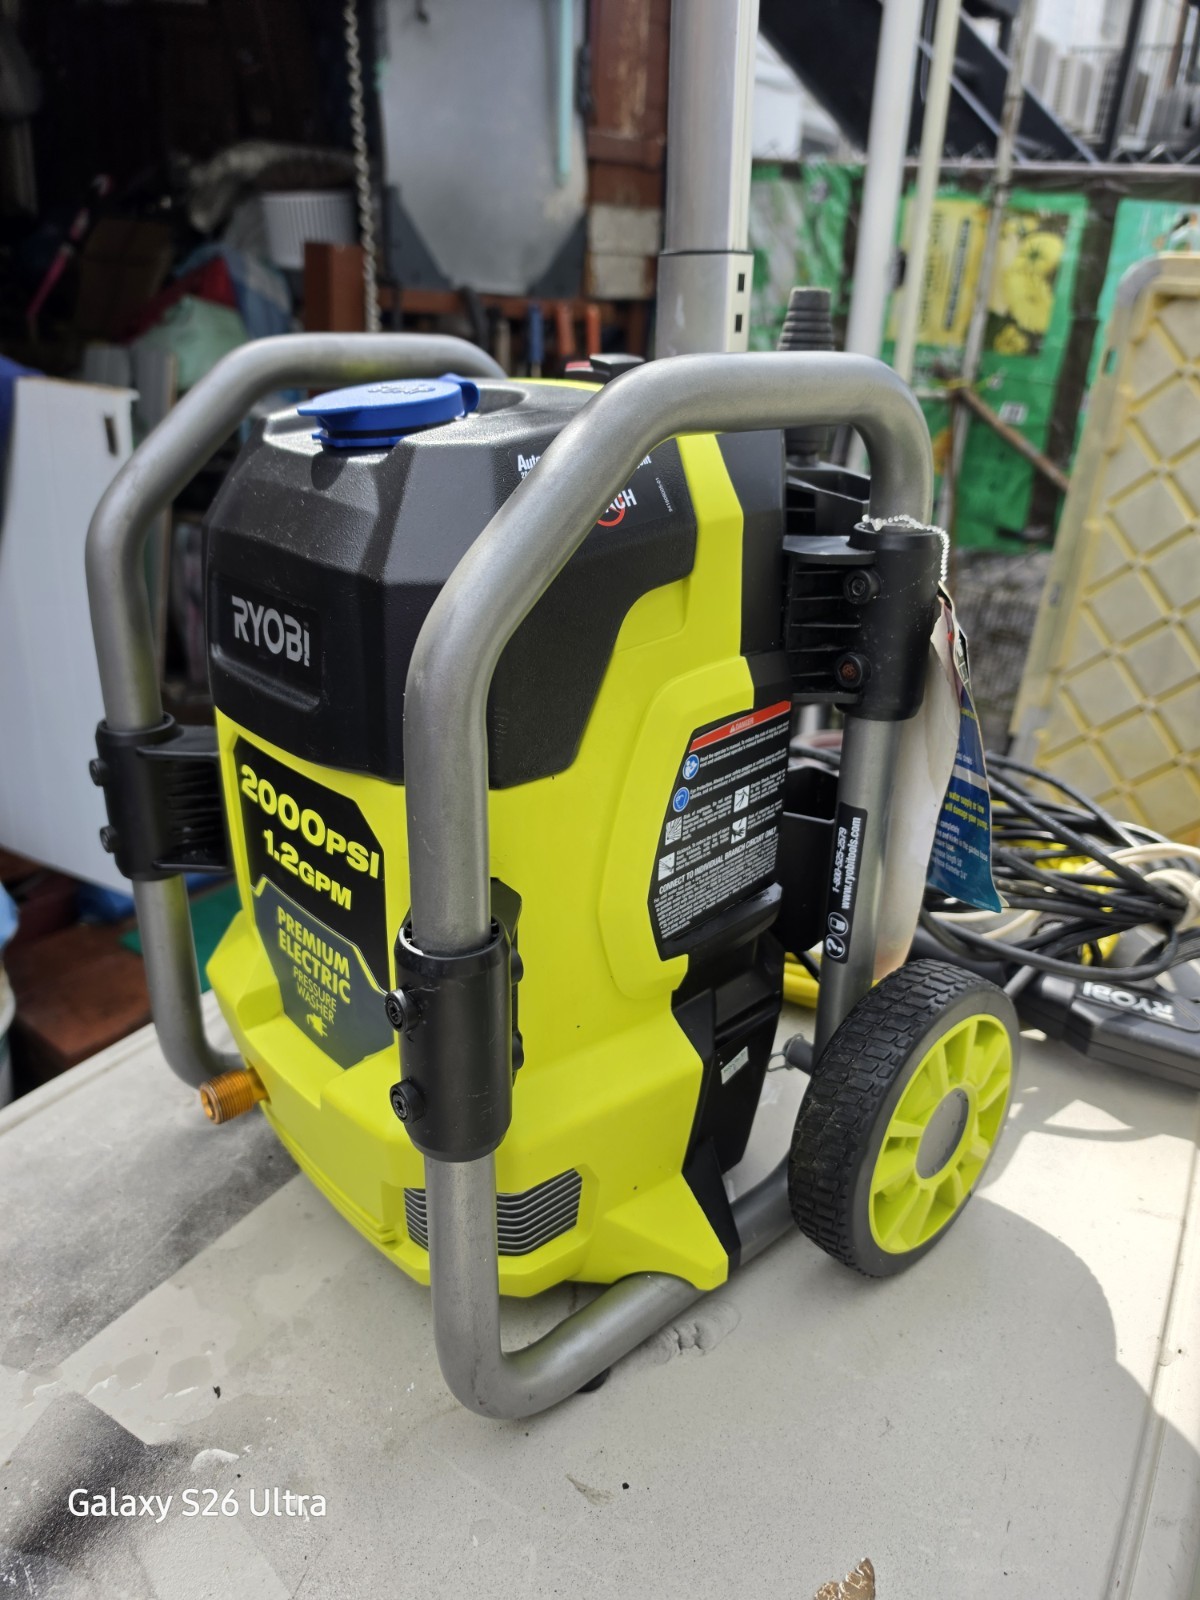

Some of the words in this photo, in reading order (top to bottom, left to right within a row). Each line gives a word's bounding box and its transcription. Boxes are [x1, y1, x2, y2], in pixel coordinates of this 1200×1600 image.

[605, 489, 637, 513] CH
[232, 595, 310, 667] RYOBI
[241, 764, 379, 879] 2000PSI
[264, 829, 351, 910] 1.2GPM
[659, 876, 685, 894] CONNECT
[686, 870, 694, 880] TO
[694, 855, 724, 874] INDIVIDUAL
[842, 817, 861, 909] www.ryobitools.com
[277, 905, 350, 978] PREMIUM
[279, 928, 350, 1004] ELECTRIC
[293, 965, 337, 1012] PRESSURE
[297, 982, 334, 1024] WASHER
[1082, 981, 1175, 1022] RYOBI
